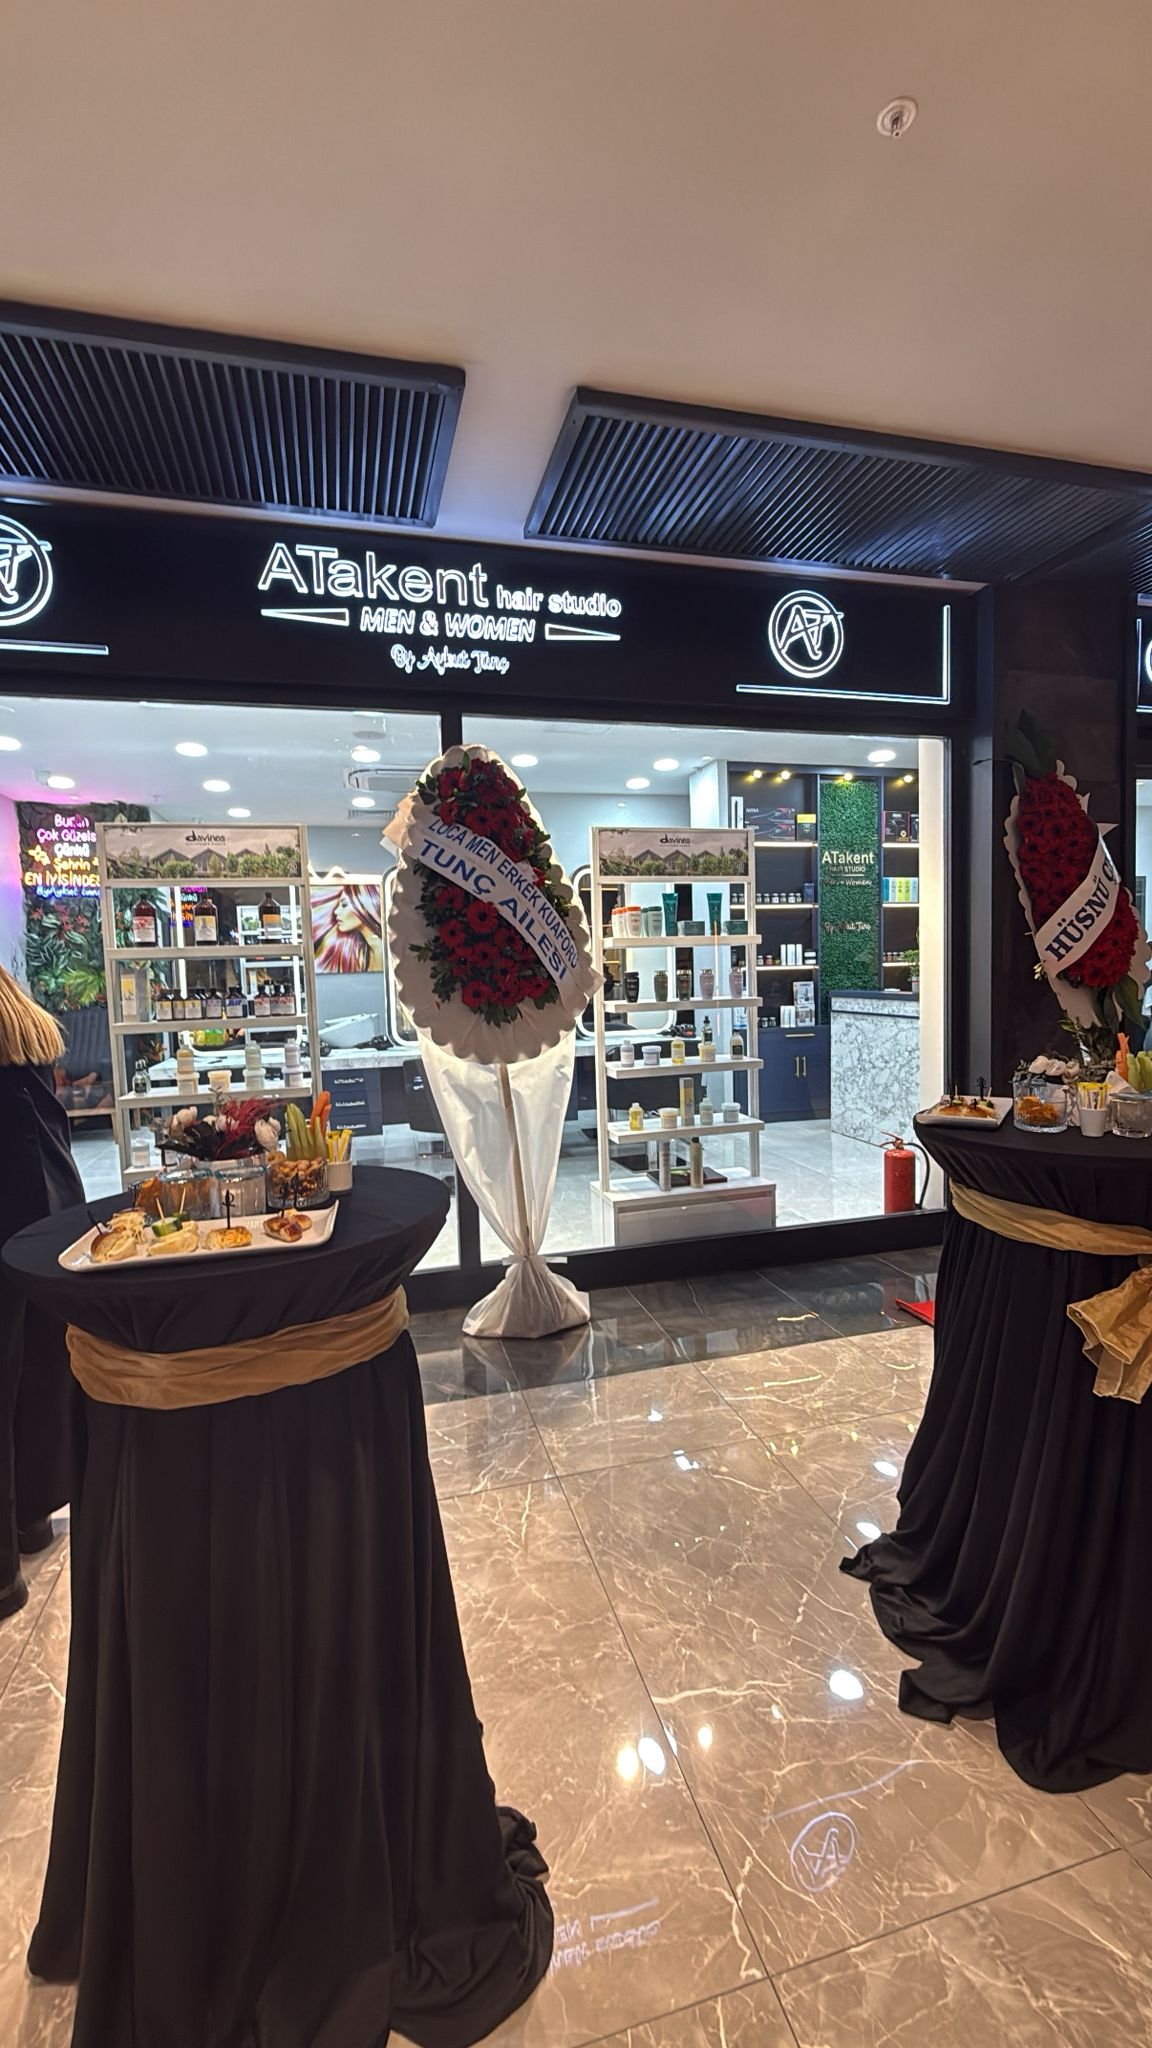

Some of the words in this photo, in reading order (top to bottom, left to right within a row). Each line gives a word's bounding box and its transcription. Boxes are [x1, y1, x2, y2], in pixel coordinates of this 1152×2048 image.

[257, 542, 489, 608] ATakent
[496, 584, 544, 611] hair
[548, 589, 623, 618] studio
[360, 606, 416, 635] MEN
[419, 613, 440, 637] &
[445, 612, 536, 643] WOMEN
[391, 643, 416, 674] By
[416, 645, 471, 676] Aykut
[185, 830, 226, 842] davines
[421, 838, 496, 895] TUNÇ
[465, 835, 501, 864] MEN
[497, 858, 541, 907] ERKEK
[822, 851, 874, 864] ATakent
[24, 871, 43, 886] EN
[1045, 875, 1110, 962] HÜSNÜ
